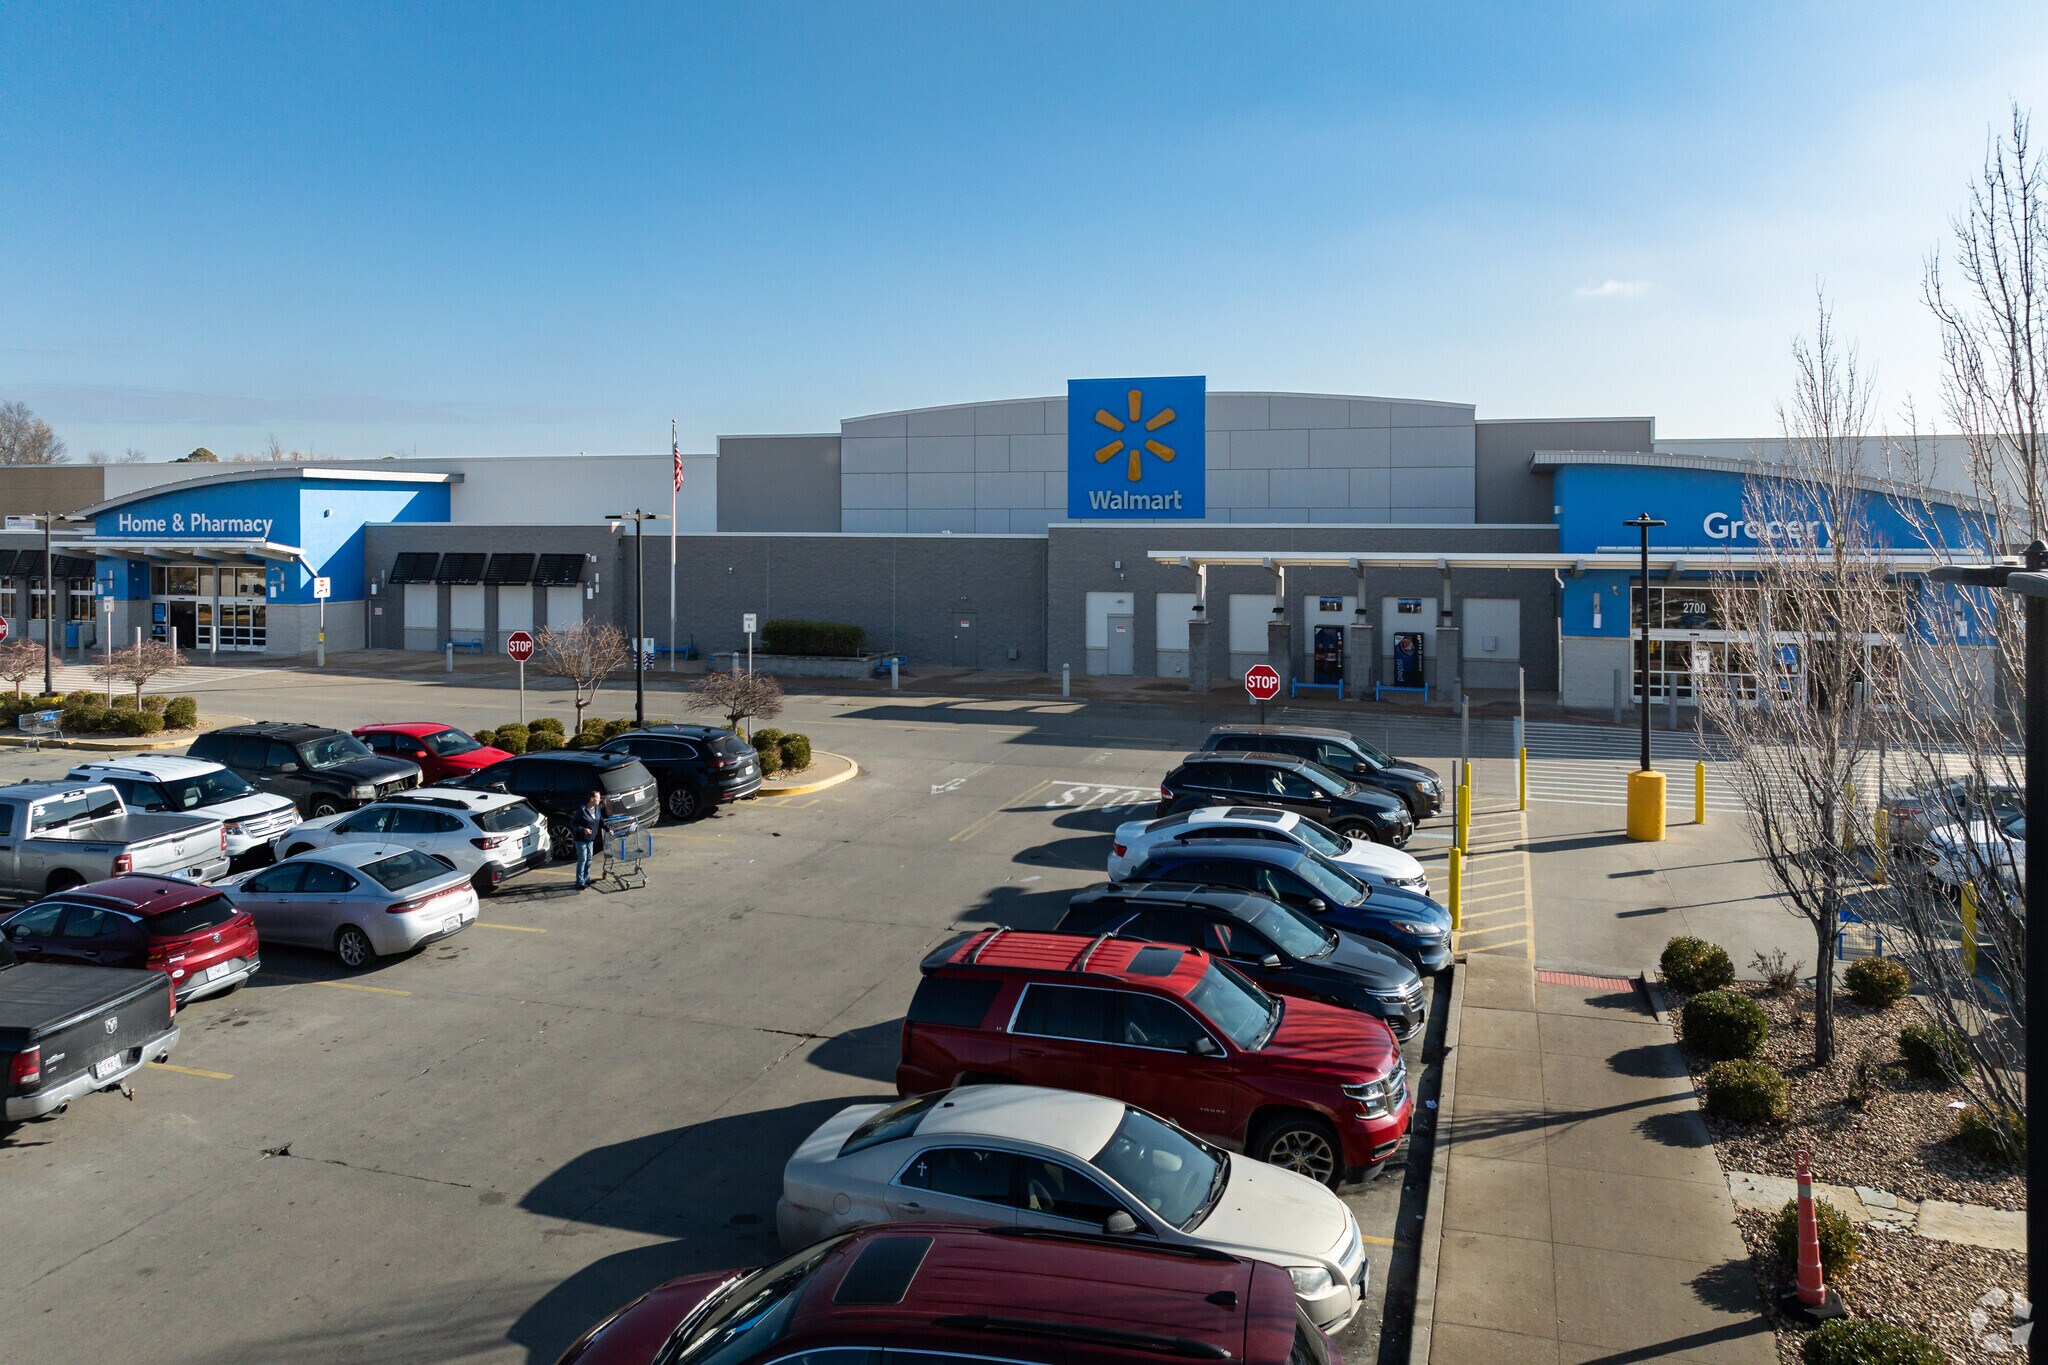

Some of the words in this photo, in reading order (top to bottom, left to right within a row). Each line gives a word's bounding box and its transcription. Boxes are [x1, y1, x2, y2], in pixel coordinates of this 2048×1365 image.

[1088, 490, 1182, 510] Walmart
[119, 513, 166, 532] Home
[172, 513, 184, 532] &
[191, 513, 273, 538] Pharmacy
[1683, 602, 1706, 614] 2700
[509, 640, 532, 652] STOP
[1247, 675, 1278, 690] STOP
